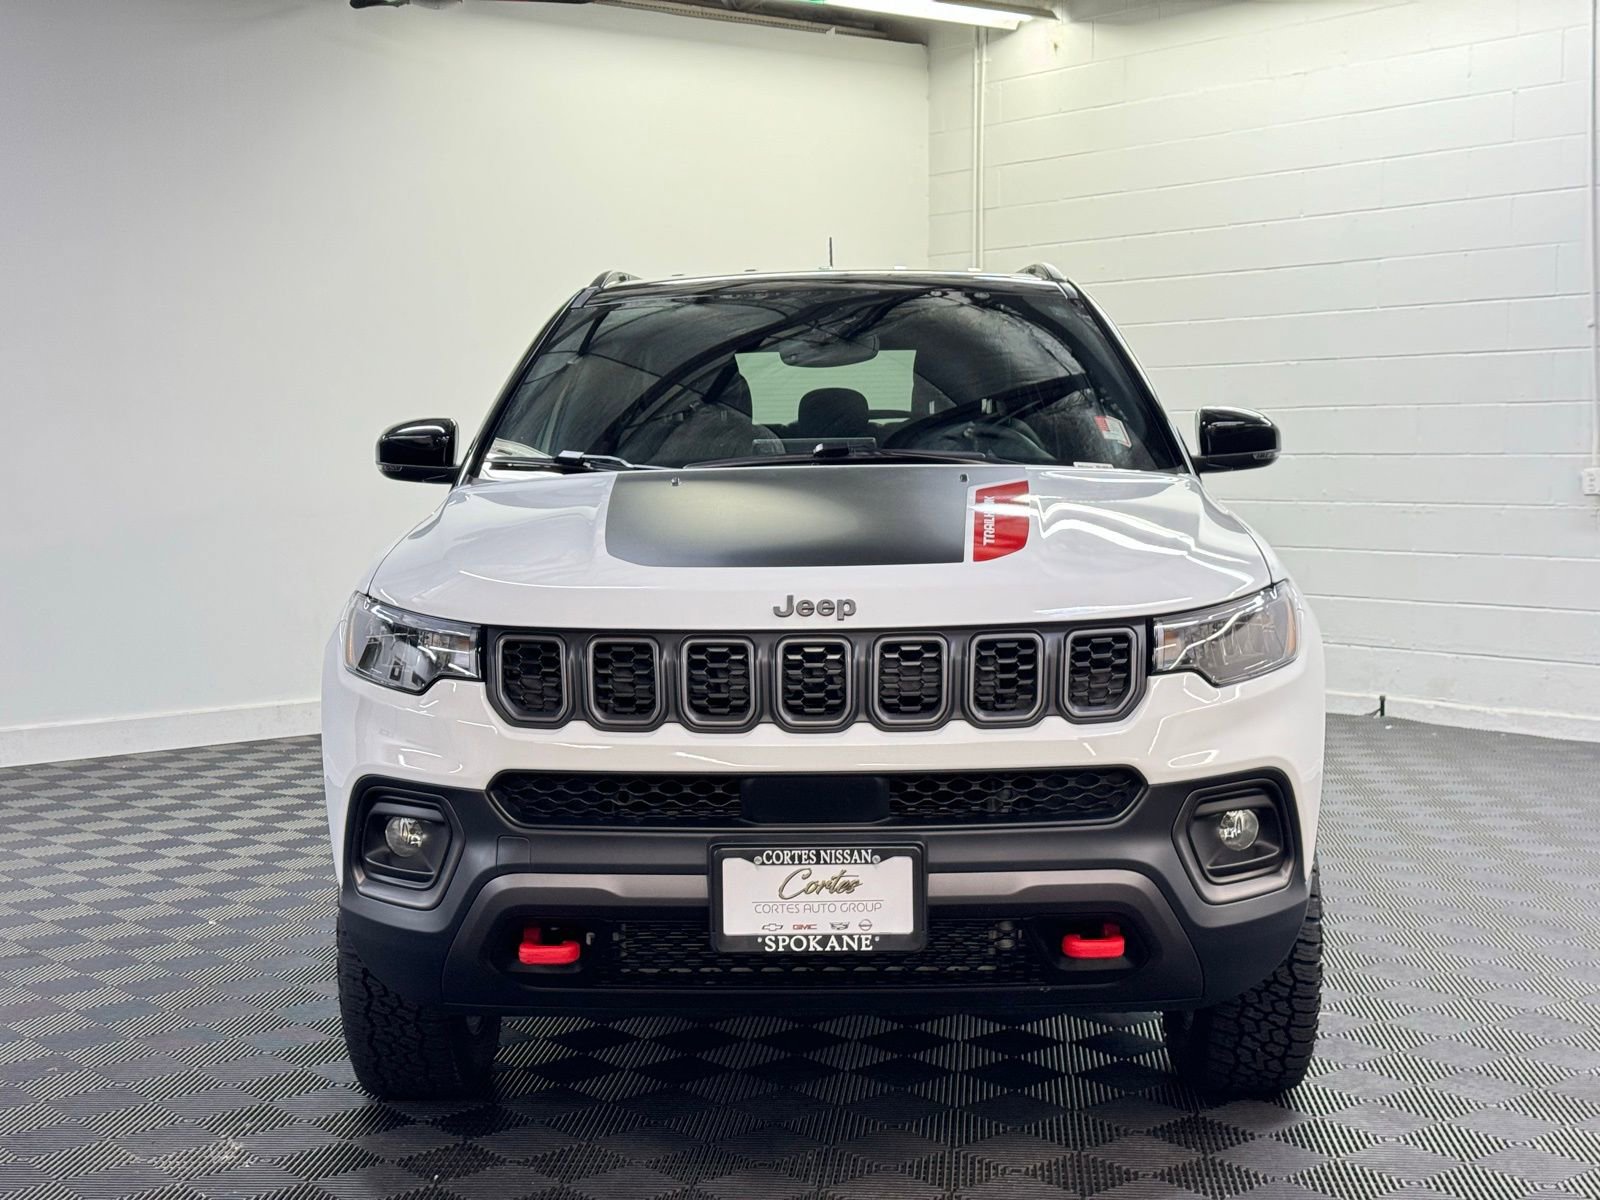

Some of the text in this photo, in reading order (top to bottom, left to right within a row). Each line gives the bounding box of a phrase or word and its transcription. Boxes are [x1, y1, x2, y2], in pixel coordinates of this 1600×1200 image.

[983, 495, 996, 546] TRAILHK
[773, 595, 857, 621] Jeep
[762, 849, 872, 865] CORTES NISSAN
[778, 868, 863, 900] Cortes
[754, 902, 882, 914] CORTES AUTO GROUP
[764, 934, 873, 952] SPOKANE
